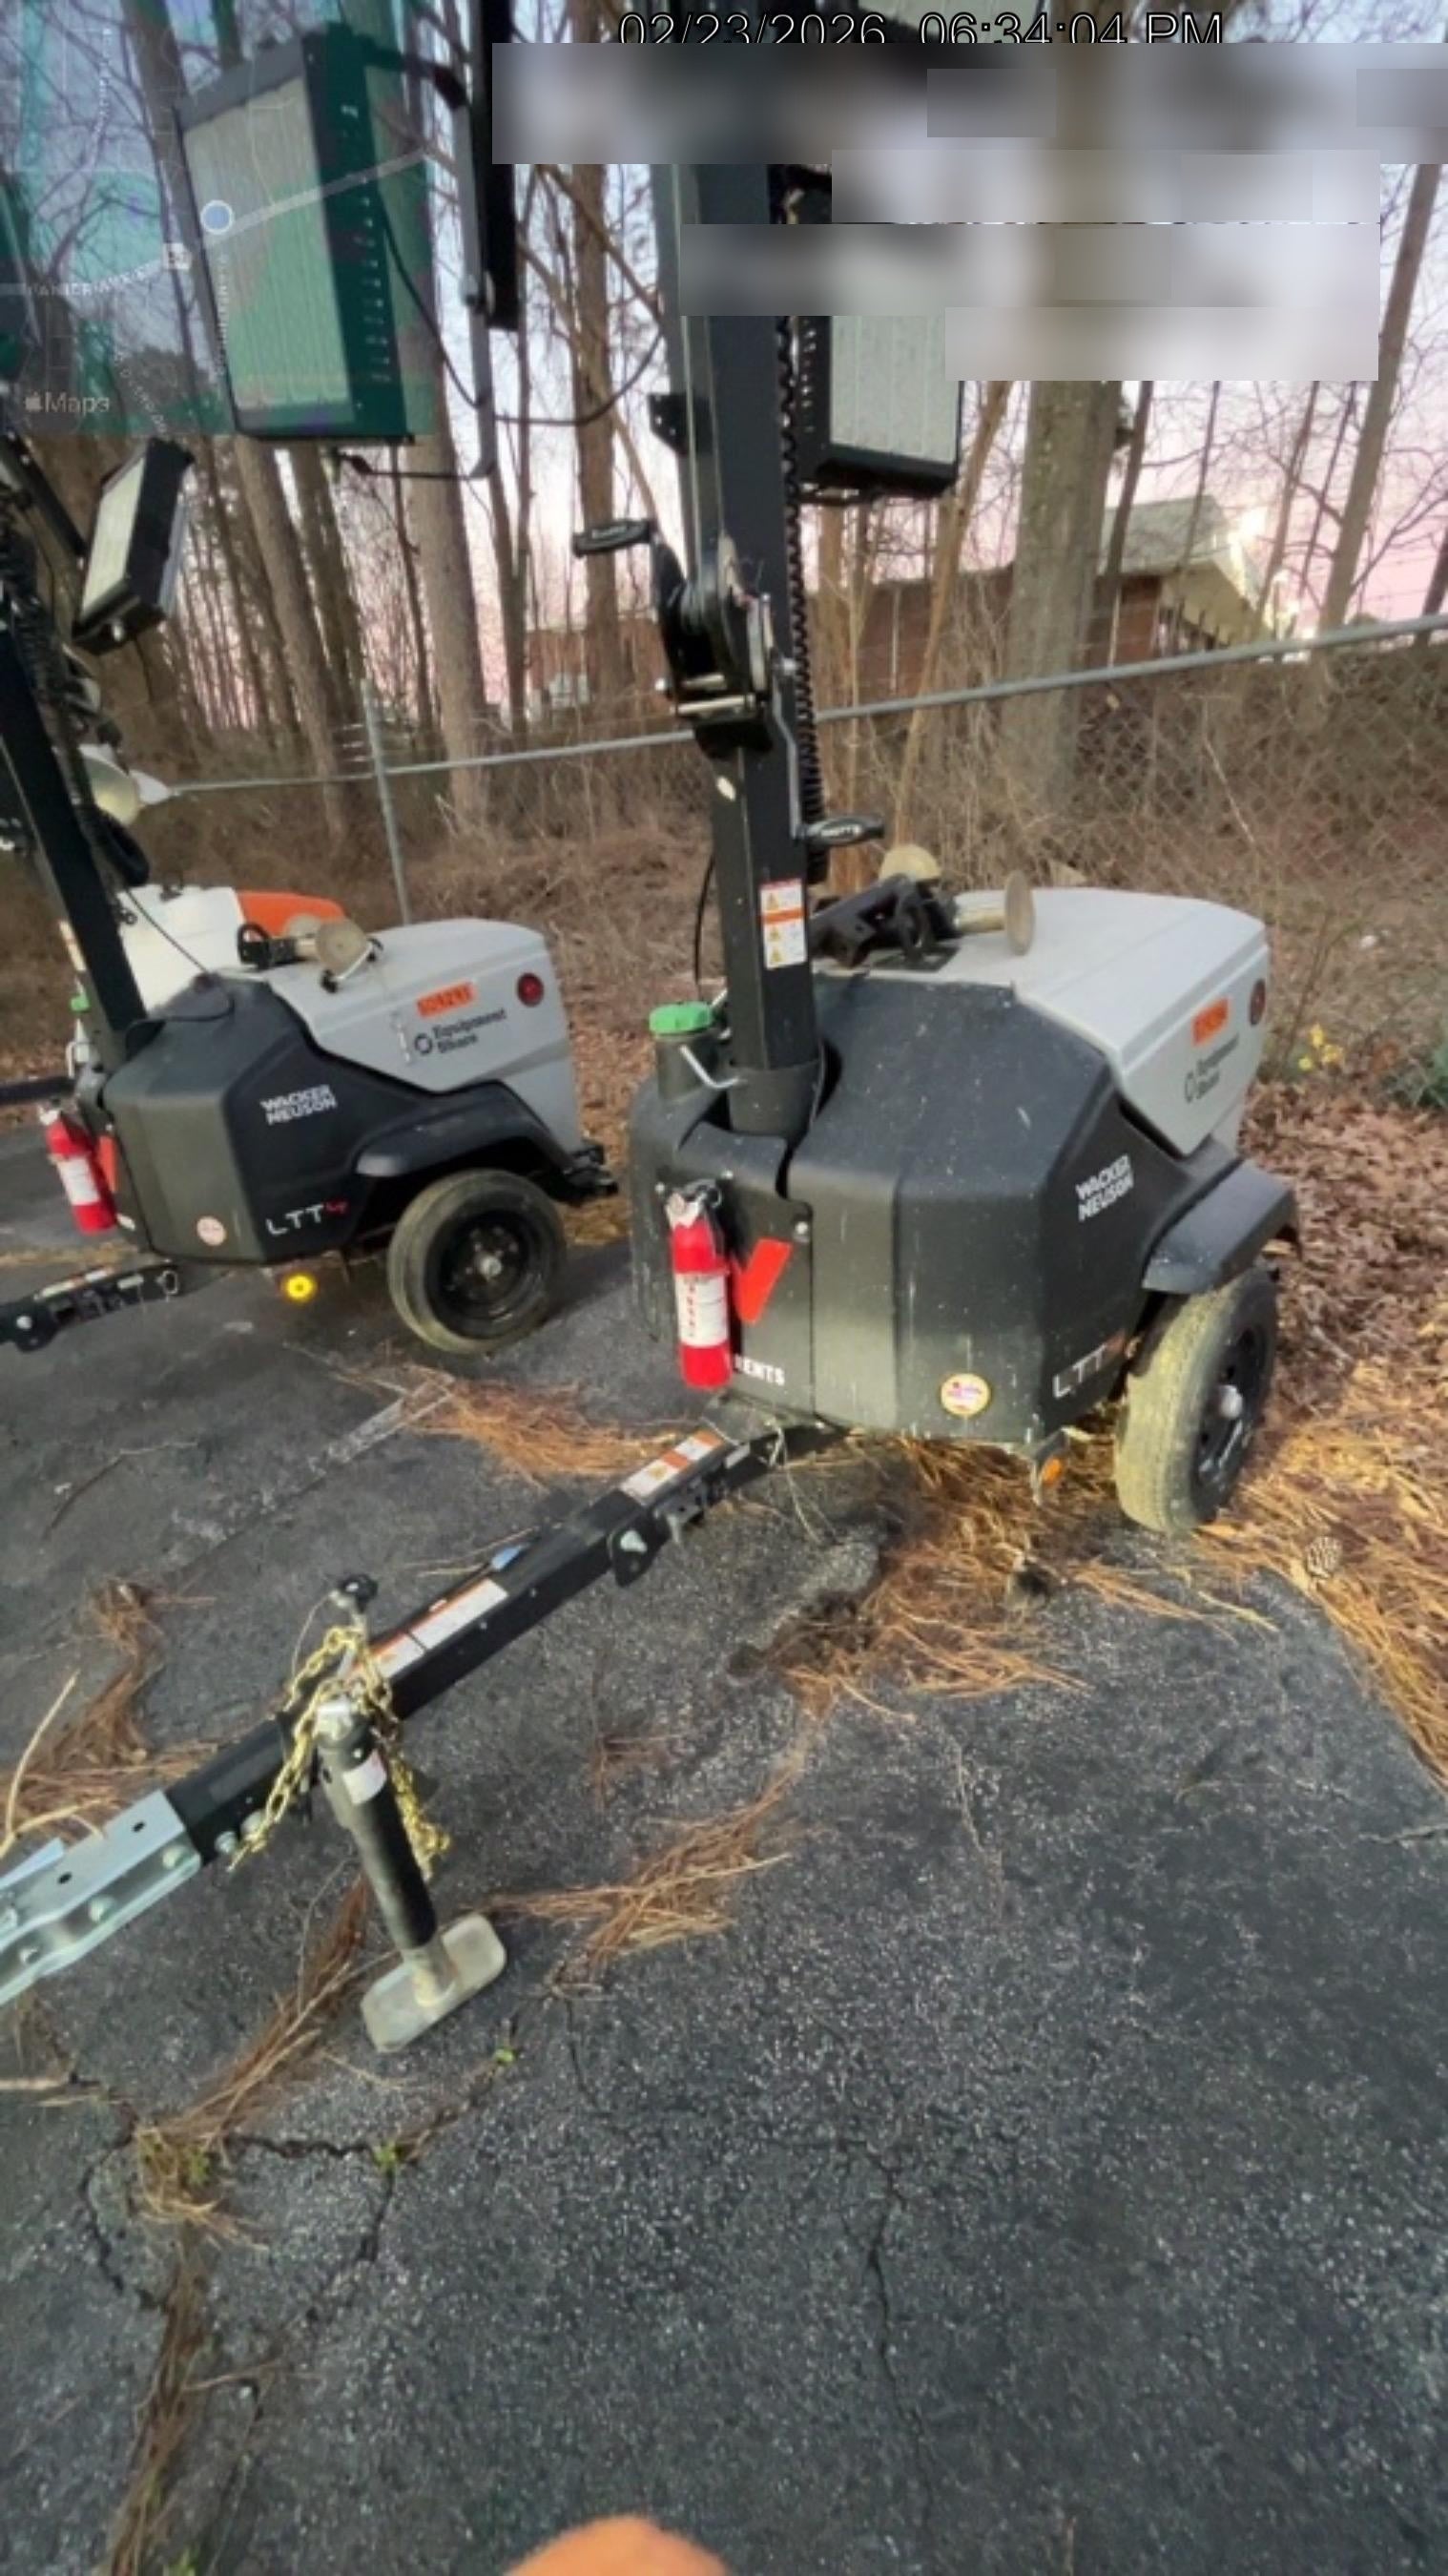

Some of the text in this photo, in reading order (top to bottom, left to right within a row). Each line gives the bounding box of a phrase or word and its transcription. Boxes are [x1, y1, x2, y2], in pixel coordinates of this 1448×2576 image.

[260, 1084, 331, 1110] WACKER
[266, 1094, 337, 1125] NEUSON
[1075, 1153, 1130, 1200] WACKER
[1078, 1171, 1134, 1221] NEUSON
[265, 1200, 349, 1236] LTT4
